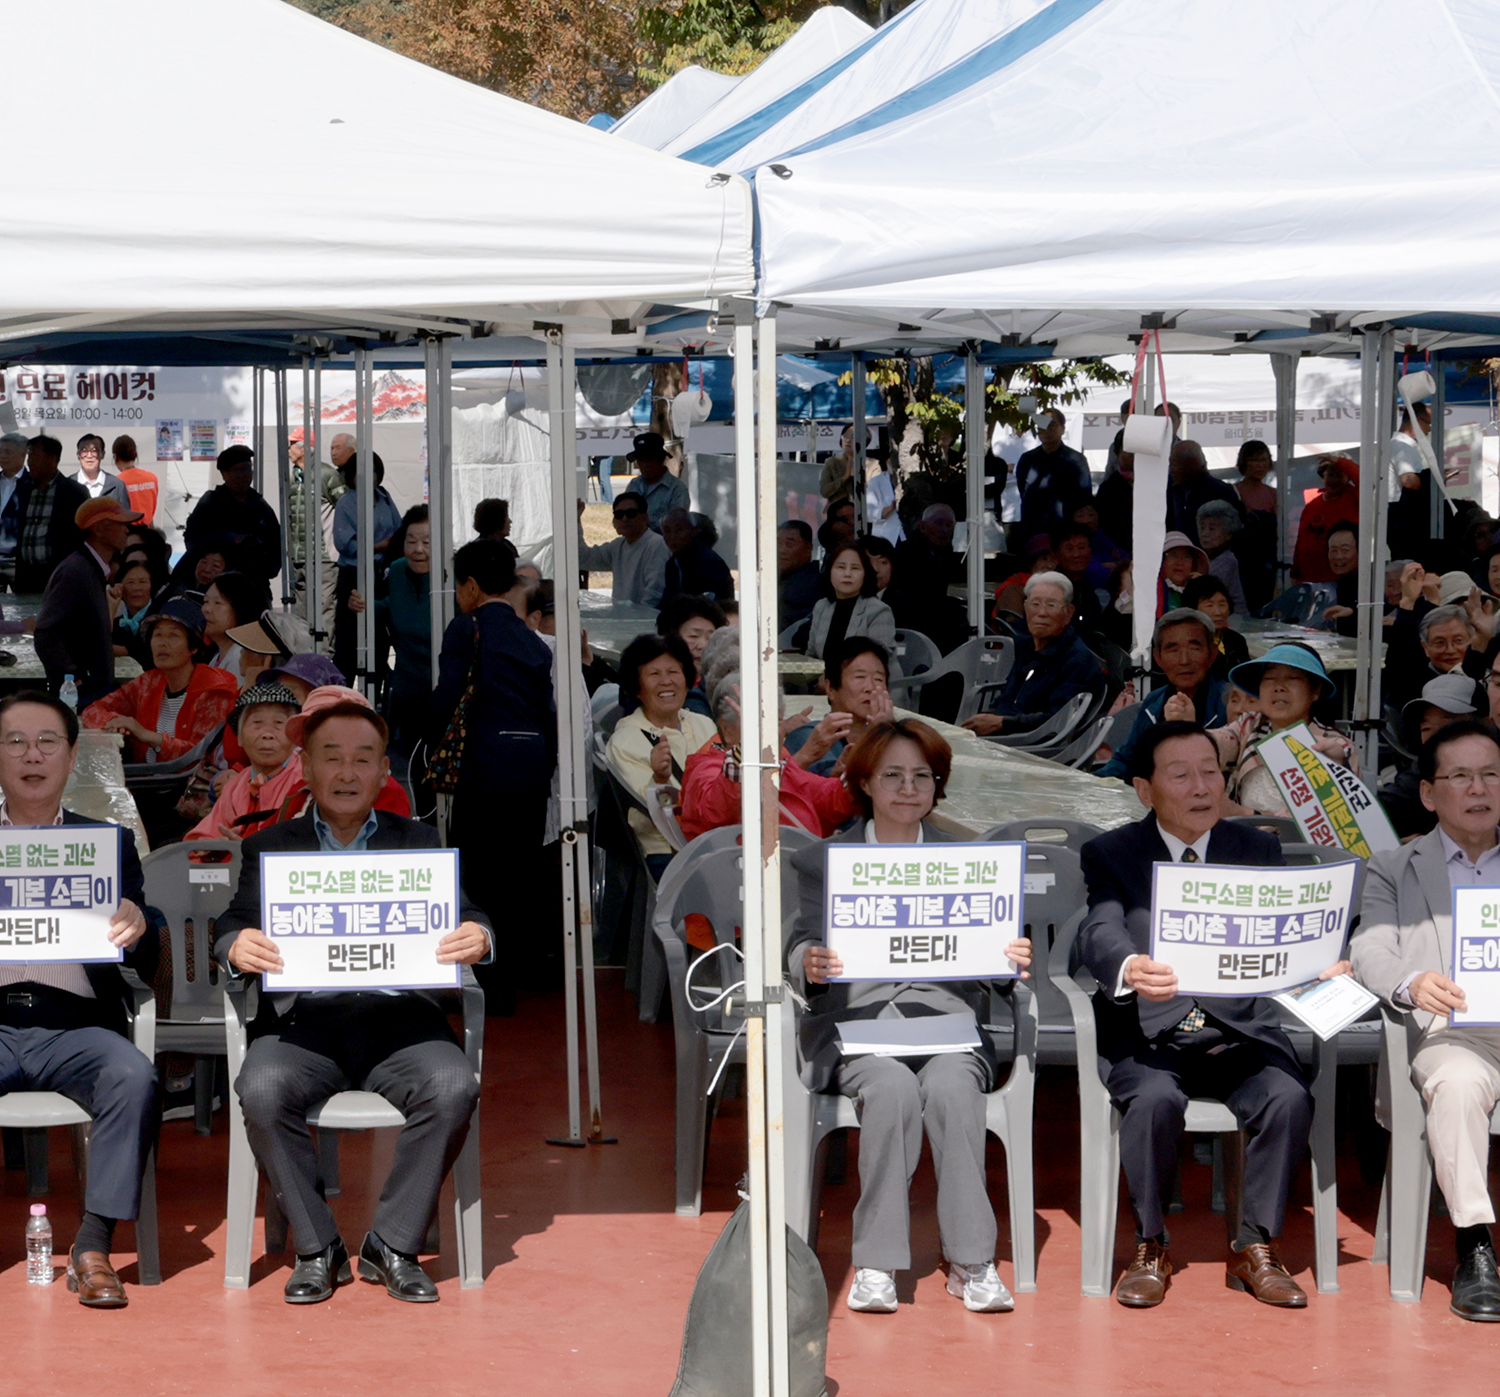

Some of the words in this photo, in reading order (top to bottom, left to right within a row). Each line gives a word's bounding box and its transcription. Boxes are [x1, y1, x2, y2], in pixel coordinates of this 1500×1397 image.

[16, 371, 67, 402] 무료
[75, 371, 156, 402] 헤어컷
[35, 406, 67, 421] 목요일
[70, 406, 101, 421] 10:00
[112, 406, 143, 421] 14:00
[1284, 735, 1331, 790] 농어촌
[1279, 767, 1314, 807] 선정
[1326, 762, 1372, 814] 괴산군
[26, 844, 59, 867] 없는
[64, 843, 96, 866] 괴산
[289, 870, 356, 894] 인구소멸
[361, 870, 394, 893] 없는
[399, 868, 432, 892] 괴산
[852, 862, 920, 886] 인구소멸
[926, 862, 959, 885] 없는
[964, 861, 998, 884] 괴산
[5, 878, 45, 907] 기본
[51, 876, 112, 906] 소득이
[1182, 881, 1253, 907] 인구소멸
[1258, 885, 1293, 907] 없는
[1298, 880, 1332, 905] 괴산
[272, 903, 334, 935] 농어촌
[339, 903, 380, 934] 기본
[385, 902, 449, 932] 소득이
[833, 895, 897, 926] 농어촌
[902, 896, 944, 925] 기본
[949, 894, 1013, 924] 소득이
[1162, 912, 1227, 944] 농어촌
[1233, 916, 1276, 945] 기본
[1280, 907, 1344, 943] 소득이
[328, 942, 395, 972] 만든다!
[890, 935, 957, 963] 만든다!
[1218, 952, 1288, 980] 만든다!
